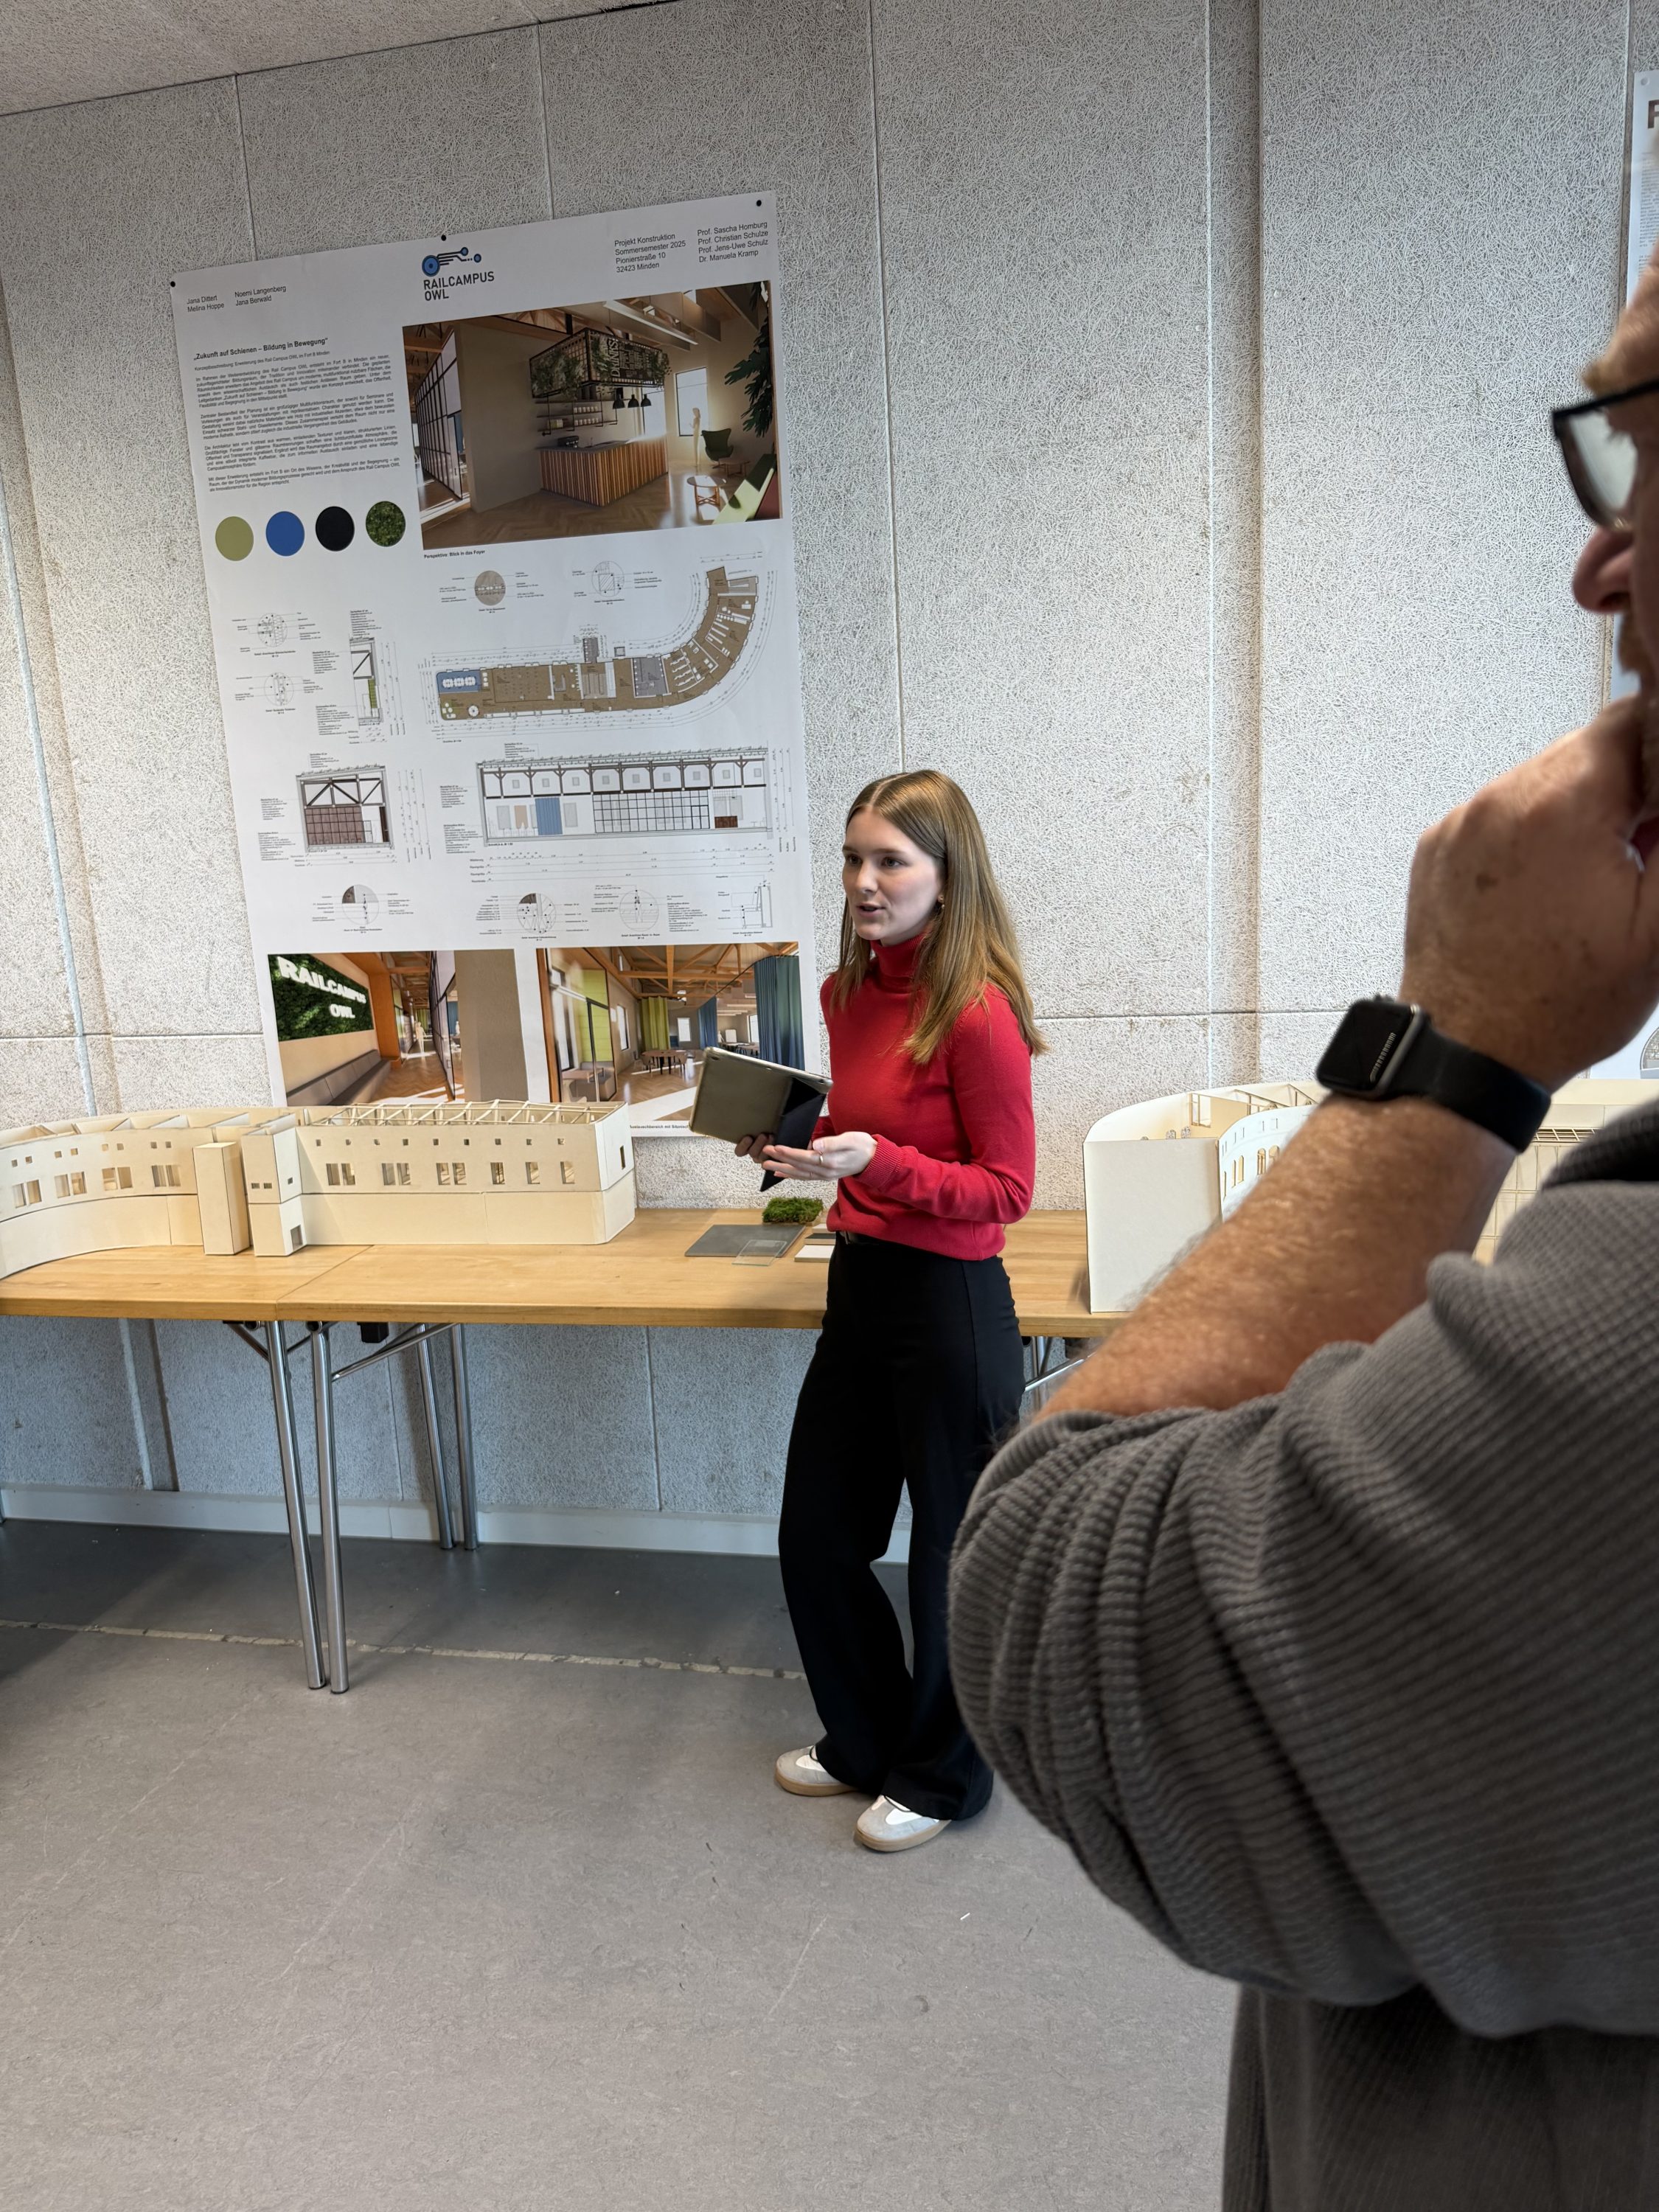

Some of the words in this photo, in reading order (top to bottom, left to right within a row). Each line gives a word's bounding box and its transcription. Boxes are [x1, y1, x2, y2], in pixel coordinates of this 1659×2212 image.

[697, 228, 712, 236] Prof.
[714, 226, 737, 234] Sascha
[739, 222, 768, 231] Homburg
[614, 238, 636, 247] Projekt
[637, 234, 675, 243] Konstruktion
[714, 234, 742, 243] Christian
[743, 230, 768, 239] Schulze
[615, 243, 669, 256] Sommersemester
[670, 240, 686, 248] 2025
[698, 246, 712, 254] Prof.
[714, 243, 745, 251] Jens-Uwe
[747, 239, 768, 248] Schulz
[616, 254, 656, 264] Pionierstraße
[709, 252, 736, 261] Manuela
[616, 265, 636, 273] 32423
[637, 262, 659, 271] Minden
[423, 271, 495, 290] RAILCAMPUS
[234, 290, 252, 298] Noemi
[254, 285, 286, 295] Langenberg
[425, 288, 450, 301] OWL
[250, 295, 272, 304] Berwald
[187, 305, 205, 313] Melina
[206, 302, 224, 310] Hoppe
[230, 347, 257, 355] Schienen
[277, 956, 366, 1004] RAILCAMPUS
[329, 1004, 355, 1018] OWL
